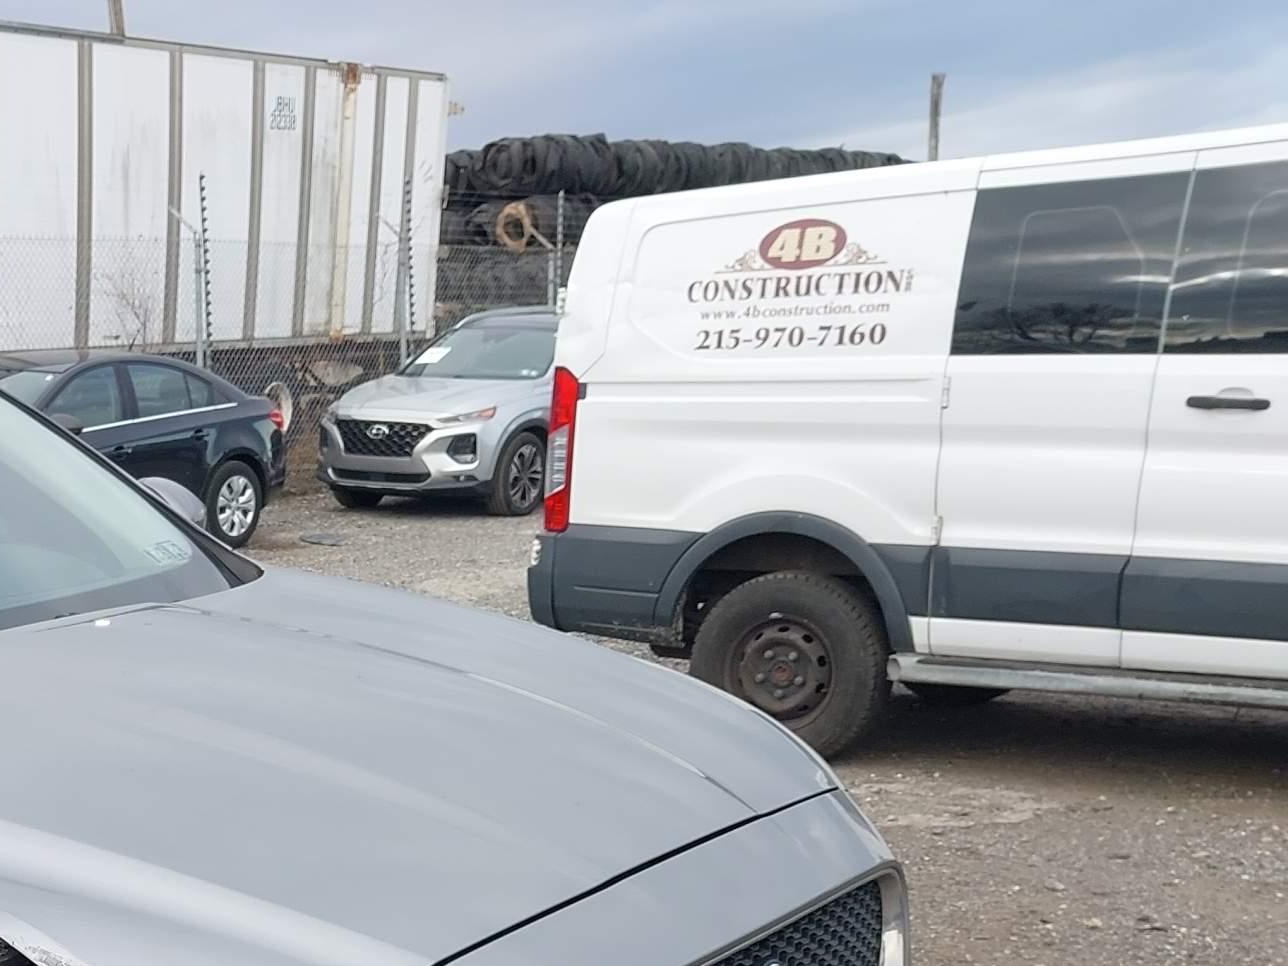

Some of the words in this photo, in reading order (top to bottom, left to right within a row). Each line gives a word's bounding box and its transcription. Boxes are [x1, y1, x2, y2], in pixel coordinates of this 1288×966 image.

[767, 226, 838, 263] 4B
[687, 269, 904, 303] CONSTRUCTION
[700, 302, 891, 321] www.4bconstruction.com
[694, 322, 887, 351] 215-970-7160
